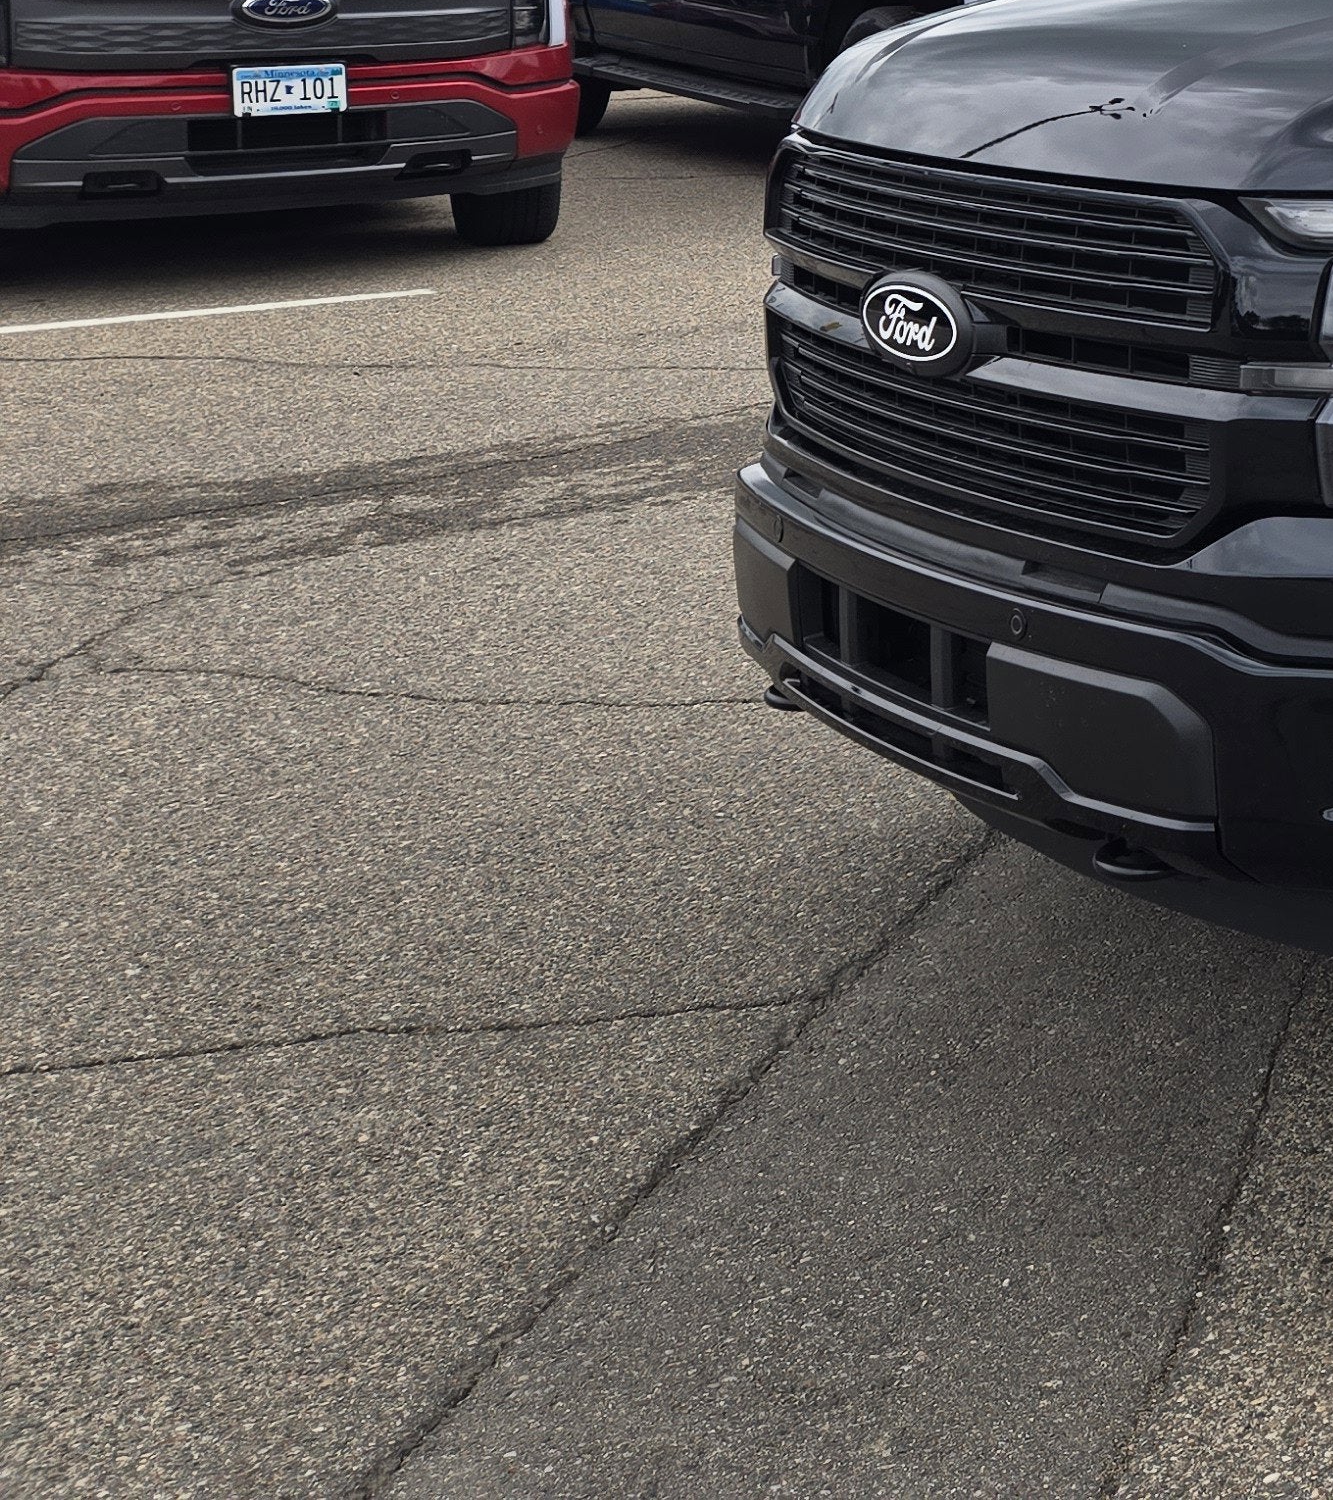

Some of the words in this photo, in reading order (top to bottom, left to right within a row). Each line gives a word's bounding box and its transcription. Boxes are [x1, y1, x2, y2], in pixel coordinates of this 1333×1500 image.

[264, 69, 315, 78] Minnesota
[240, 79, 282, 103] RHZ
[300, 77, 339, 100] 101
[879, 293, 938, 352] Ford
